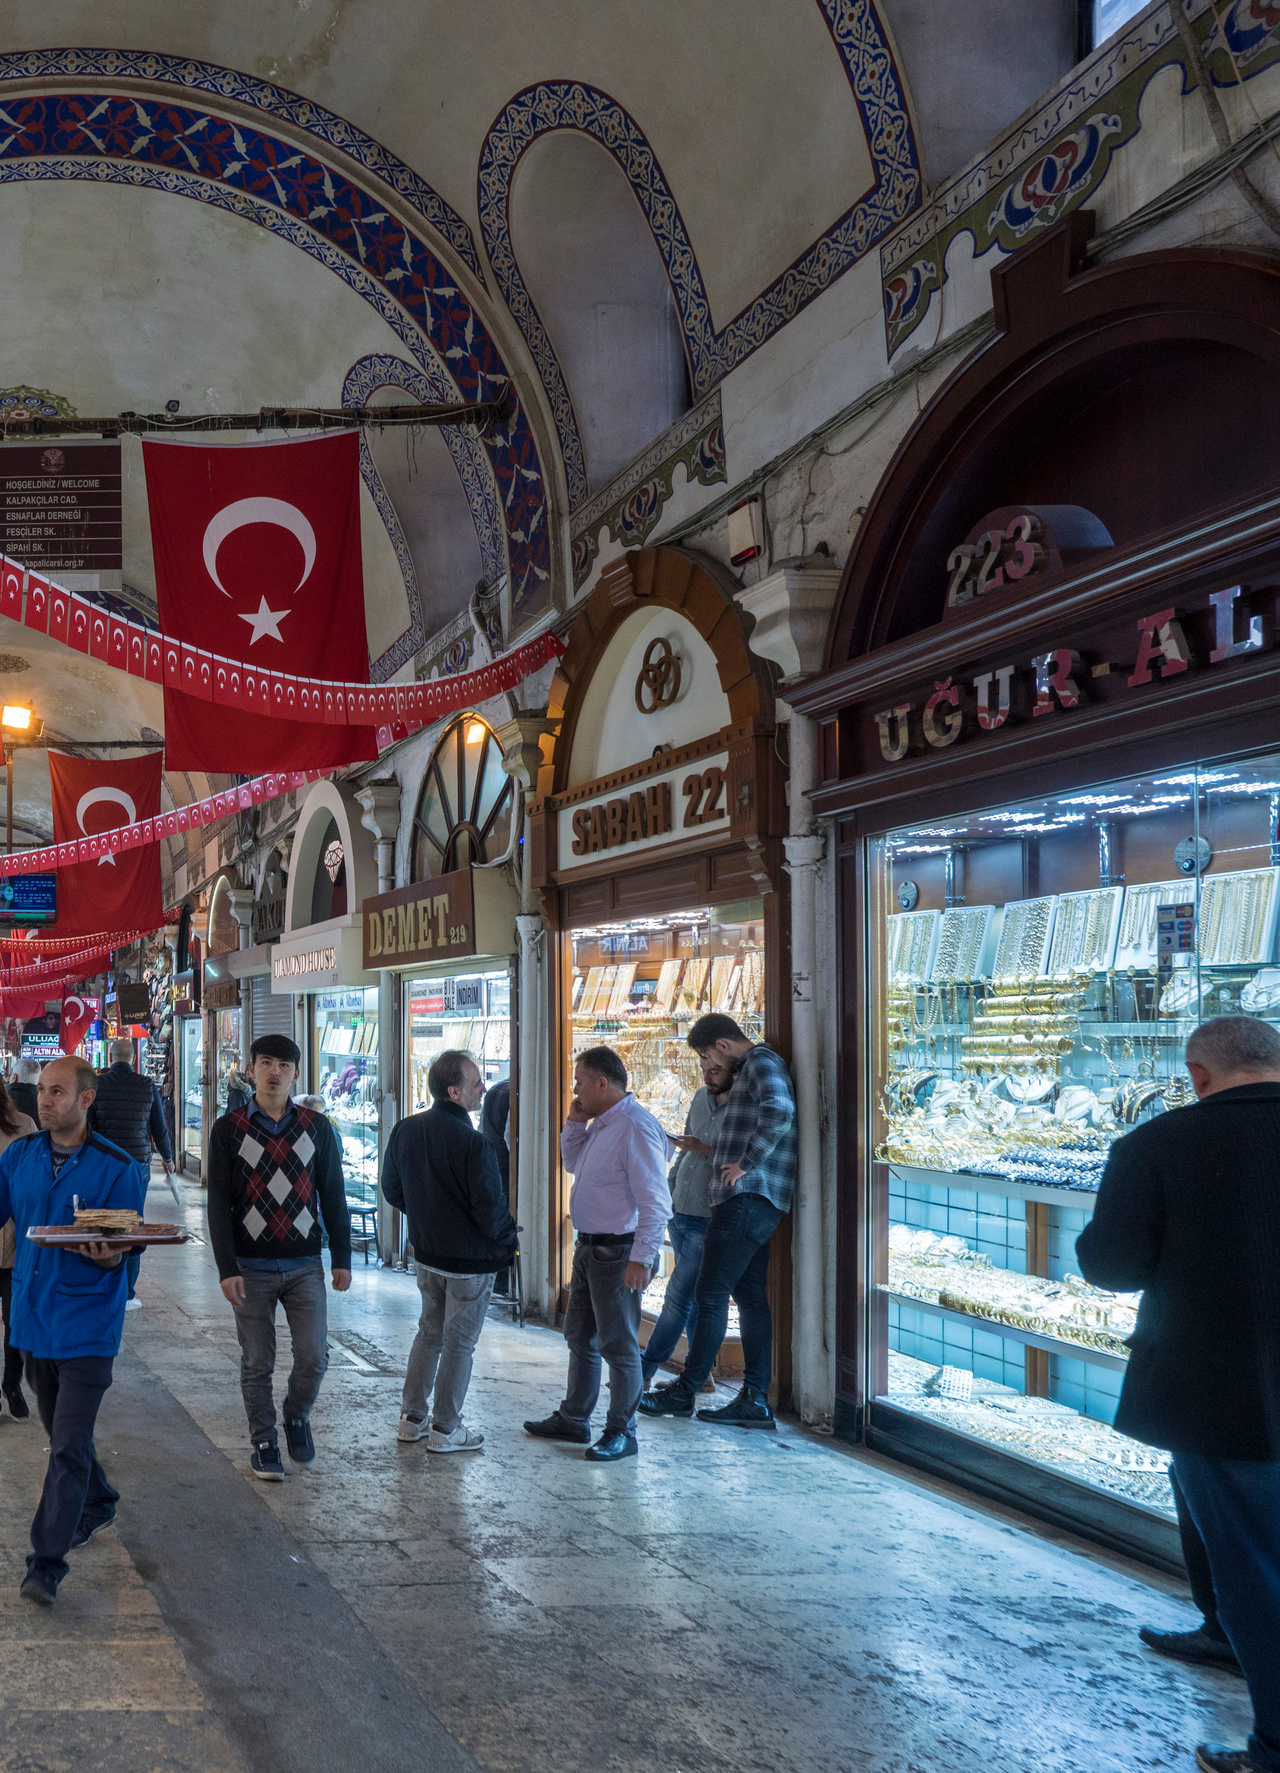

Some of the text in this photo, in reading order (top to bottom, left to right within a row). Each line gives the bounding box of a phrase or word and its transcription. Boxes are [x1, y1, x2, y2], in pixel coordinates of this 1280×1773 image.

[6, 478, 56, 491] HOŞGELDİNİZ
[61, 479, 100, 488] WELCOME
[6, 495, 79, 506] KALPAKÇILAR CAD.
[6, 509, 81, 521] ESNAFLAR DERNEĞİ
[6, 526, 56, 537] FESÇİLER SK.
[6, 541, 44, 552] SİPAHİ SK.
[947, 515, 1041, 608] 223
[572, 782, 670, 856] SABAH
[368, 893, 468, 958] DEMET 219
[274, 947, 337, 979] DIAMOND HOUSE
[444, 996, 455, 1011] SALE
